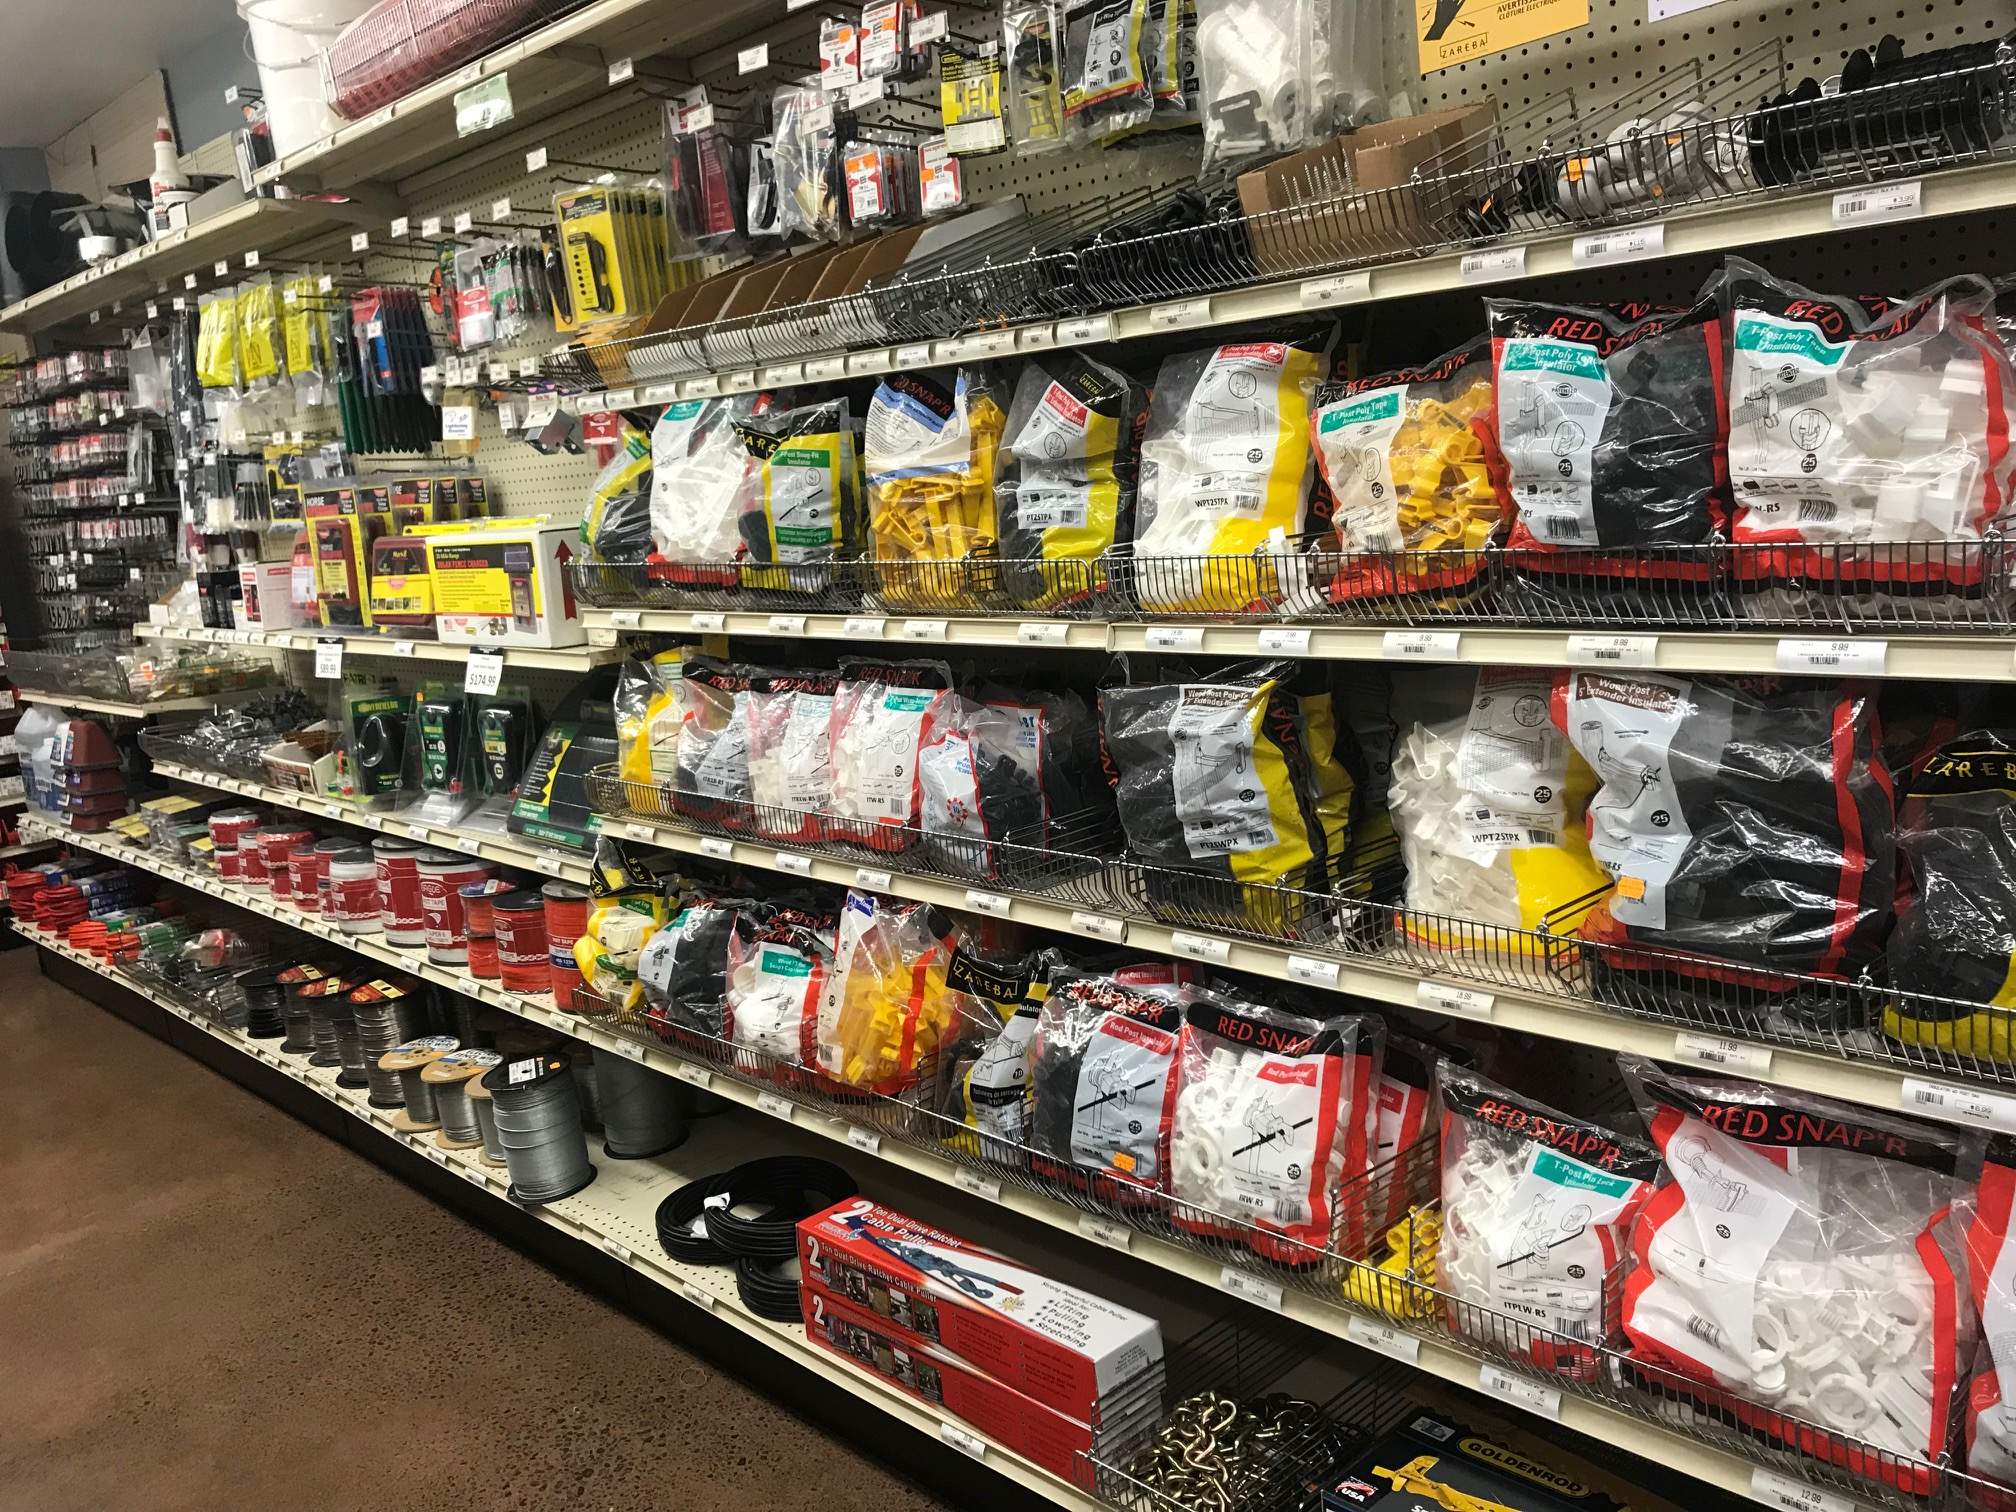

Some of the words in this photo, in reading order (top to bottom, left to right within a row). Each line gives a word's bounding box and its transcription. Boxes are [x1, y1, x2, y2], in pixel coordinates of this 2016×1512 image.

[1441, 39, 1486, 58] ZAREBA
[1784, 300, 1844, 335] RED
[1547, 316, 1604, 341] RED
[1751, 325, 1783, 340] T-Post
[1784, 332, 1805, 344] Poly
[1551, 349, 1574, 361] Poly
[1558, 461, 1572, 472] 25
[1802, 455, 1818, 467] 25
[469, 672, 497, 688] $174.99
[1626, 683, 1651, 696] Post
[1535, 788, 1551, 798] 25
[1651, 812, 1670, 824] 25
[1471, 831, 1520, 844] WPT25TPX
[954, 965, 1015, 999] ZAREBA
[1109, 1021, 1124, 1034] Rod
[1123, 1025, 1139, 1038] Post
[1217, 1015, 1254, 1040] RED
[1476, 1100, 1528, 1130] RED
[1701, 1103, 1769, 1138] RED
[1776, 1114, 1908, 1157] SNAP'R
[1288, 1166, 1301, 1175] 25
[1554, 1160, 1582, 1179] T-Post
[1583, 1172, 1596, 1183] Pin
[828, 1200, 874, 1225] 2
[873, 1205, 888, 1217] Ton
[889, 1212, 906, 1225] Dual
[906, 1220, 928, 1234] Drive
[928, 1229, 962, 1248] Ratchet
[860, 1212, 894, 1233] Cable
[895, 1228, 934, 1248] Puller
[807, 1235, 822, 1269] 2
[821, 1242, 833, 1254] Ton
[834, 1247, 849, 1261] Dual
[850, 1254, 867, 1269] Drive
[867, 1262, 894, 1282] Ratchet
[894, 1274, 915, 1292] Cable
[916, 1284, 937, 1303] Puller
[1567, 1265, 1584, 1274] 25
[812, 1295, 825, 1326] 2
[1042, 1281, 1061, 1294] Strong
[1062, 1289, 1089, 1305] Powerful
[1107, 1309, 1128, 1321] Puller
[1054, 1301, 1090, 1320] Lifting
[1042, 1314, 1092, 1341] Lowering
[1048, 1308, 1086, 1328] Pulling
[1035, 1321, 1087, 1348] Stretching
[1468, 1441, 1584, 1495] GOLDENROD
[1341, 1486, 1365, 1502] USA
